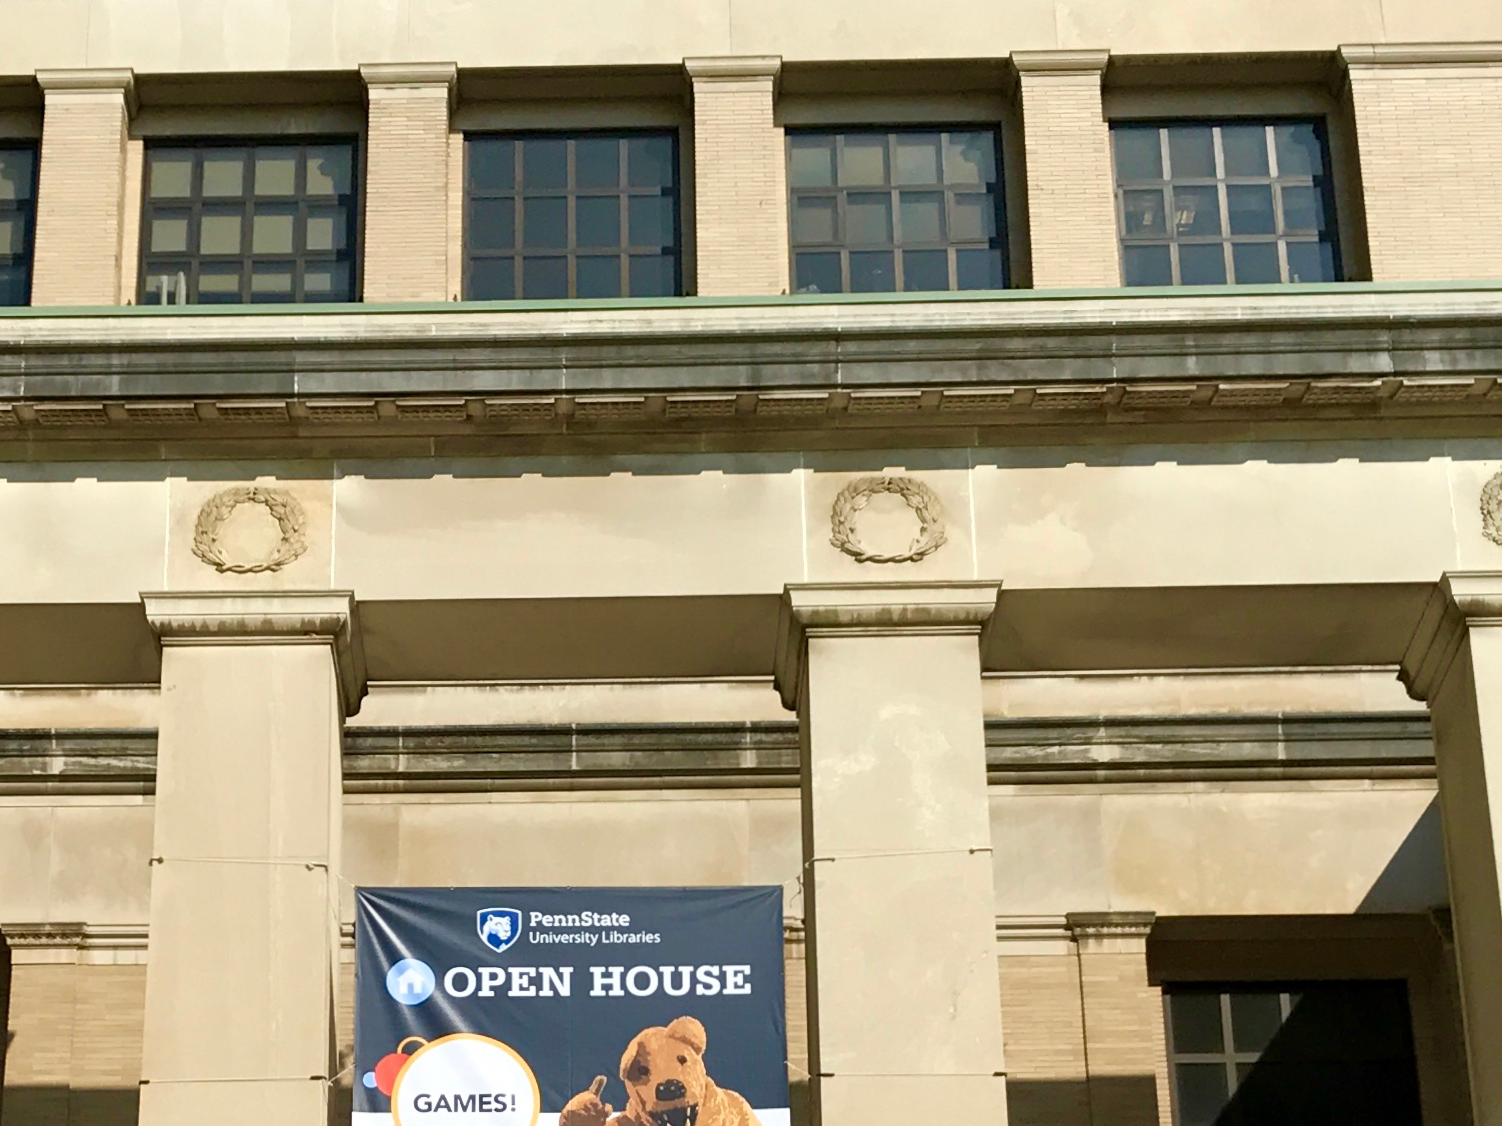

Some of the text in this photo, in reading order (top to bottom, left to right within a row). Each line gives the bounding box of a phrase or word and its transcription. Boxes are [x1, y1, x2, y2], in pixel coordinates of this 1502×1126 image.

[528, 930, 661, 946] University Libraries
[443, 964, 752, 998] OPEN HOUSE
[413, 1093, 516, 1113] GAMES!
